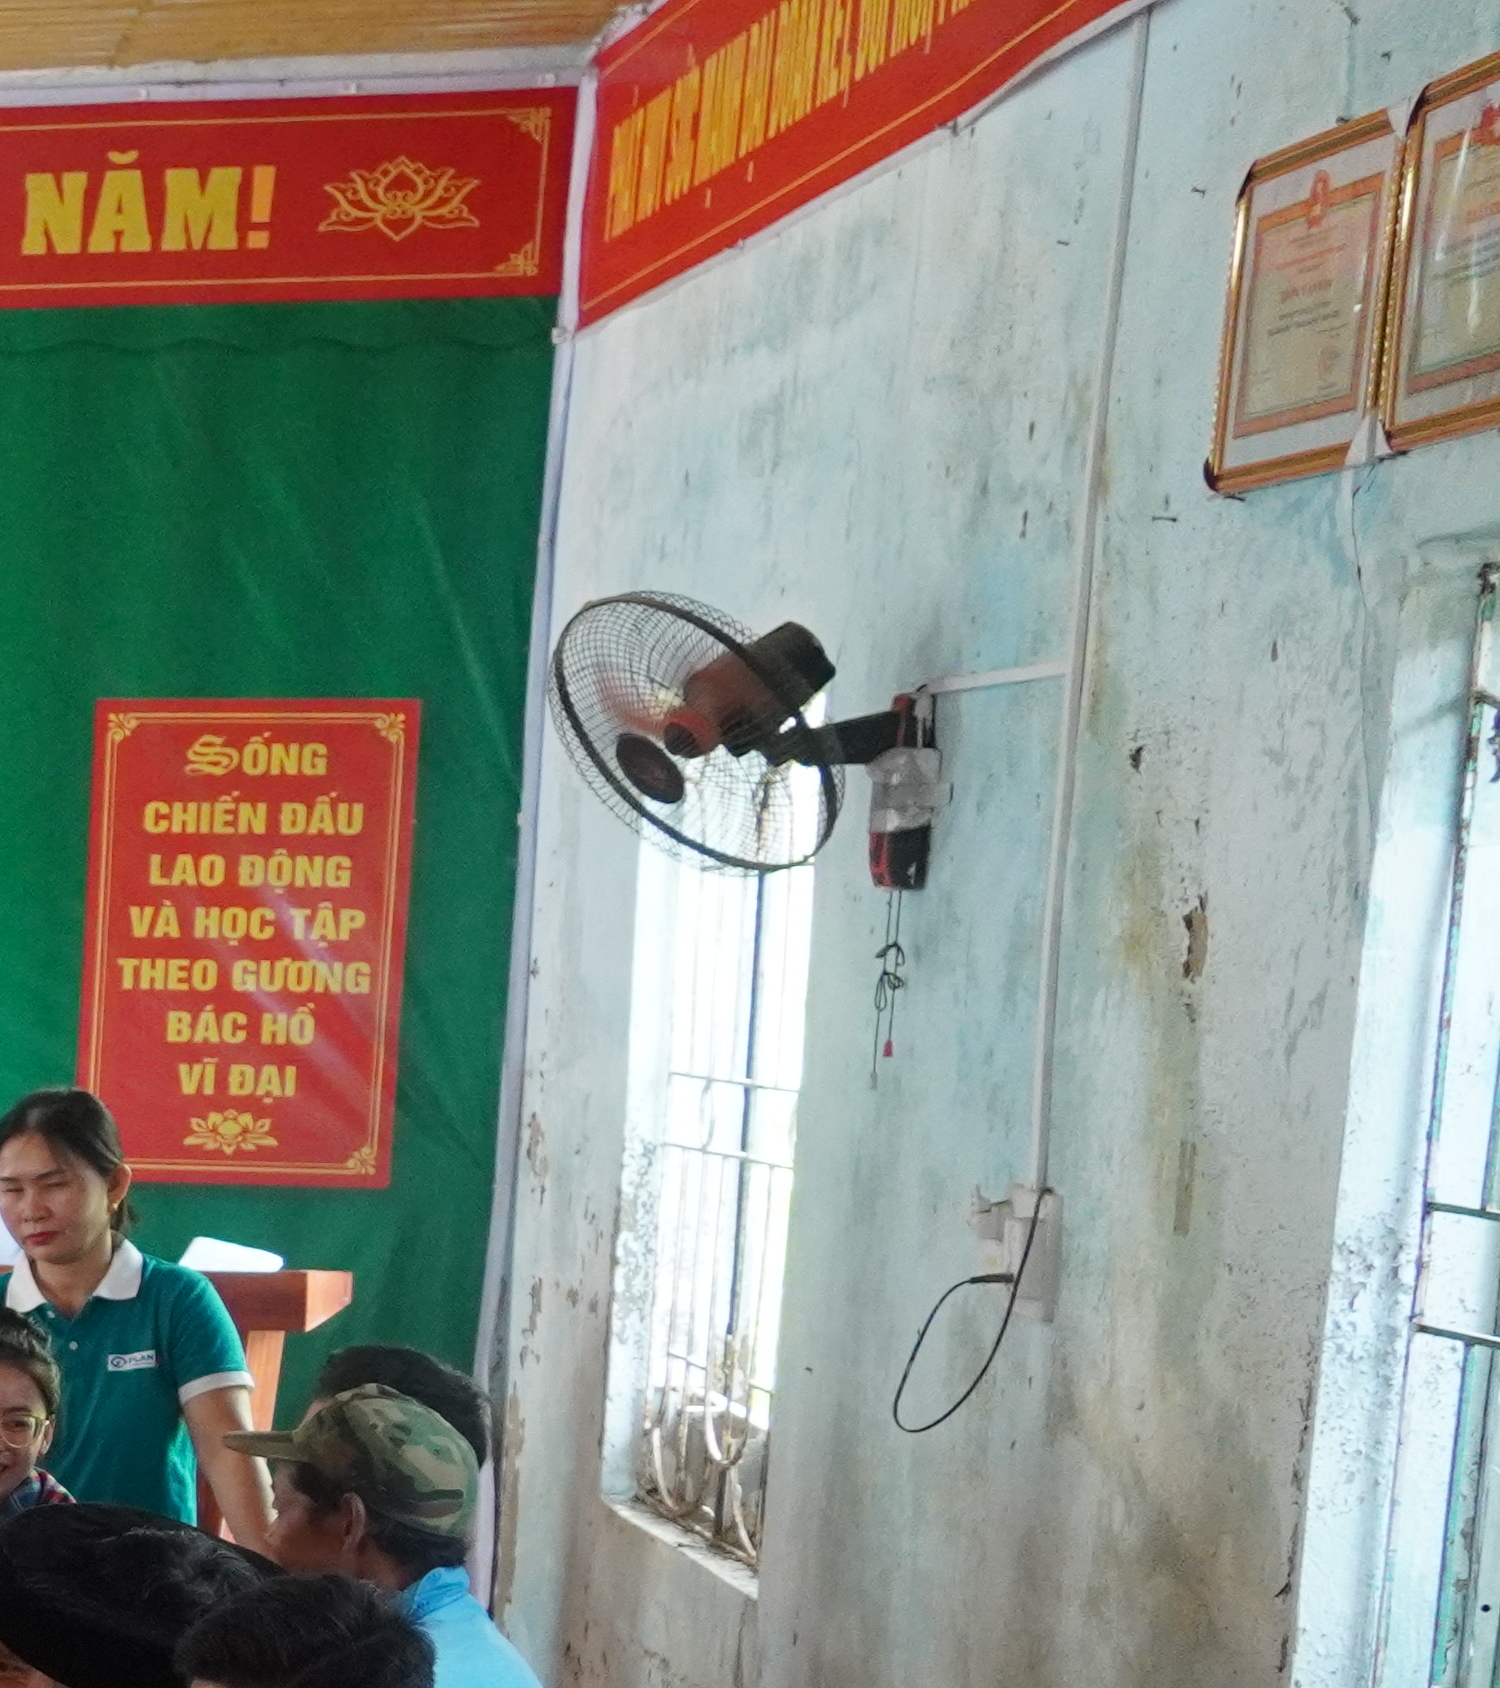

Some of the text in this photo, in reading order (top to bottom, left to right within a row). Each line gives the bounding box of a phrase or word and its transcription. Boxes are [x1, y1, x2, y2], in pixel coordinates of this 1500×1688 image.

[21, 149, 278, 256] NĂM!
[184, 731, 328, 777] SỐNG
[143, 790, 364, 836] CHIẾN ĐẤU
[148, 849, 352, 894] LAO ĐỘNG
[129, 900, 366, 948] VÀ HỌC TẬP
[117, 957, 371, 994] THEO GƯƠNG
[166, 1002, 315, 1045] BÁC HỒ
[178, 1057, 297, 1103] VĨ ĐẠI
